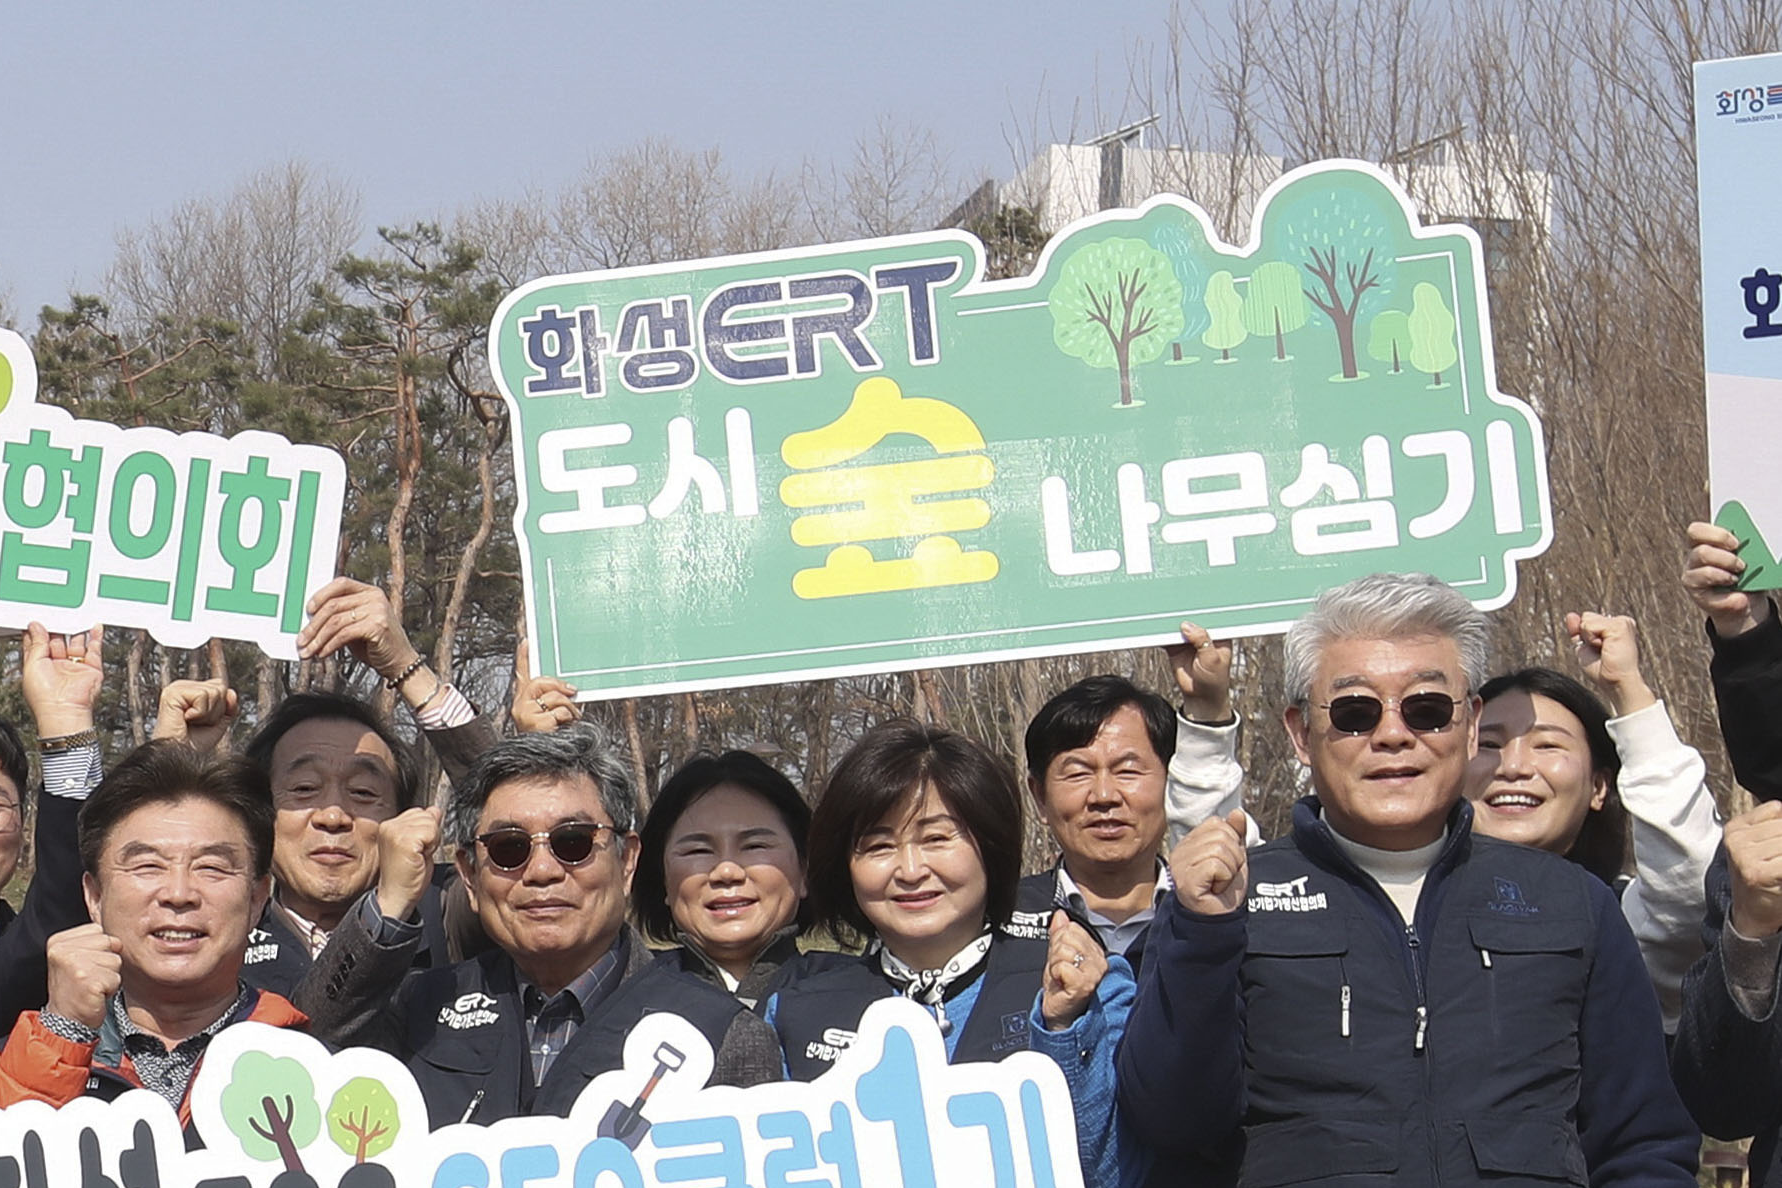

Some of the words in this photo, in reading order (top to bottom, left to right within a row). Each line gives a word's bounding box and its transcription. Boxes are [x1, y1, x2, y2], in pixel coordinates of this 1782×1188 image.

[521, 260, 960, 398] 화성ERT
[1040, 420, 1525, 577] 나무심기
[1011, 910, 1053, 927] ERT
[1256, 875, 1309, 897] ERT
